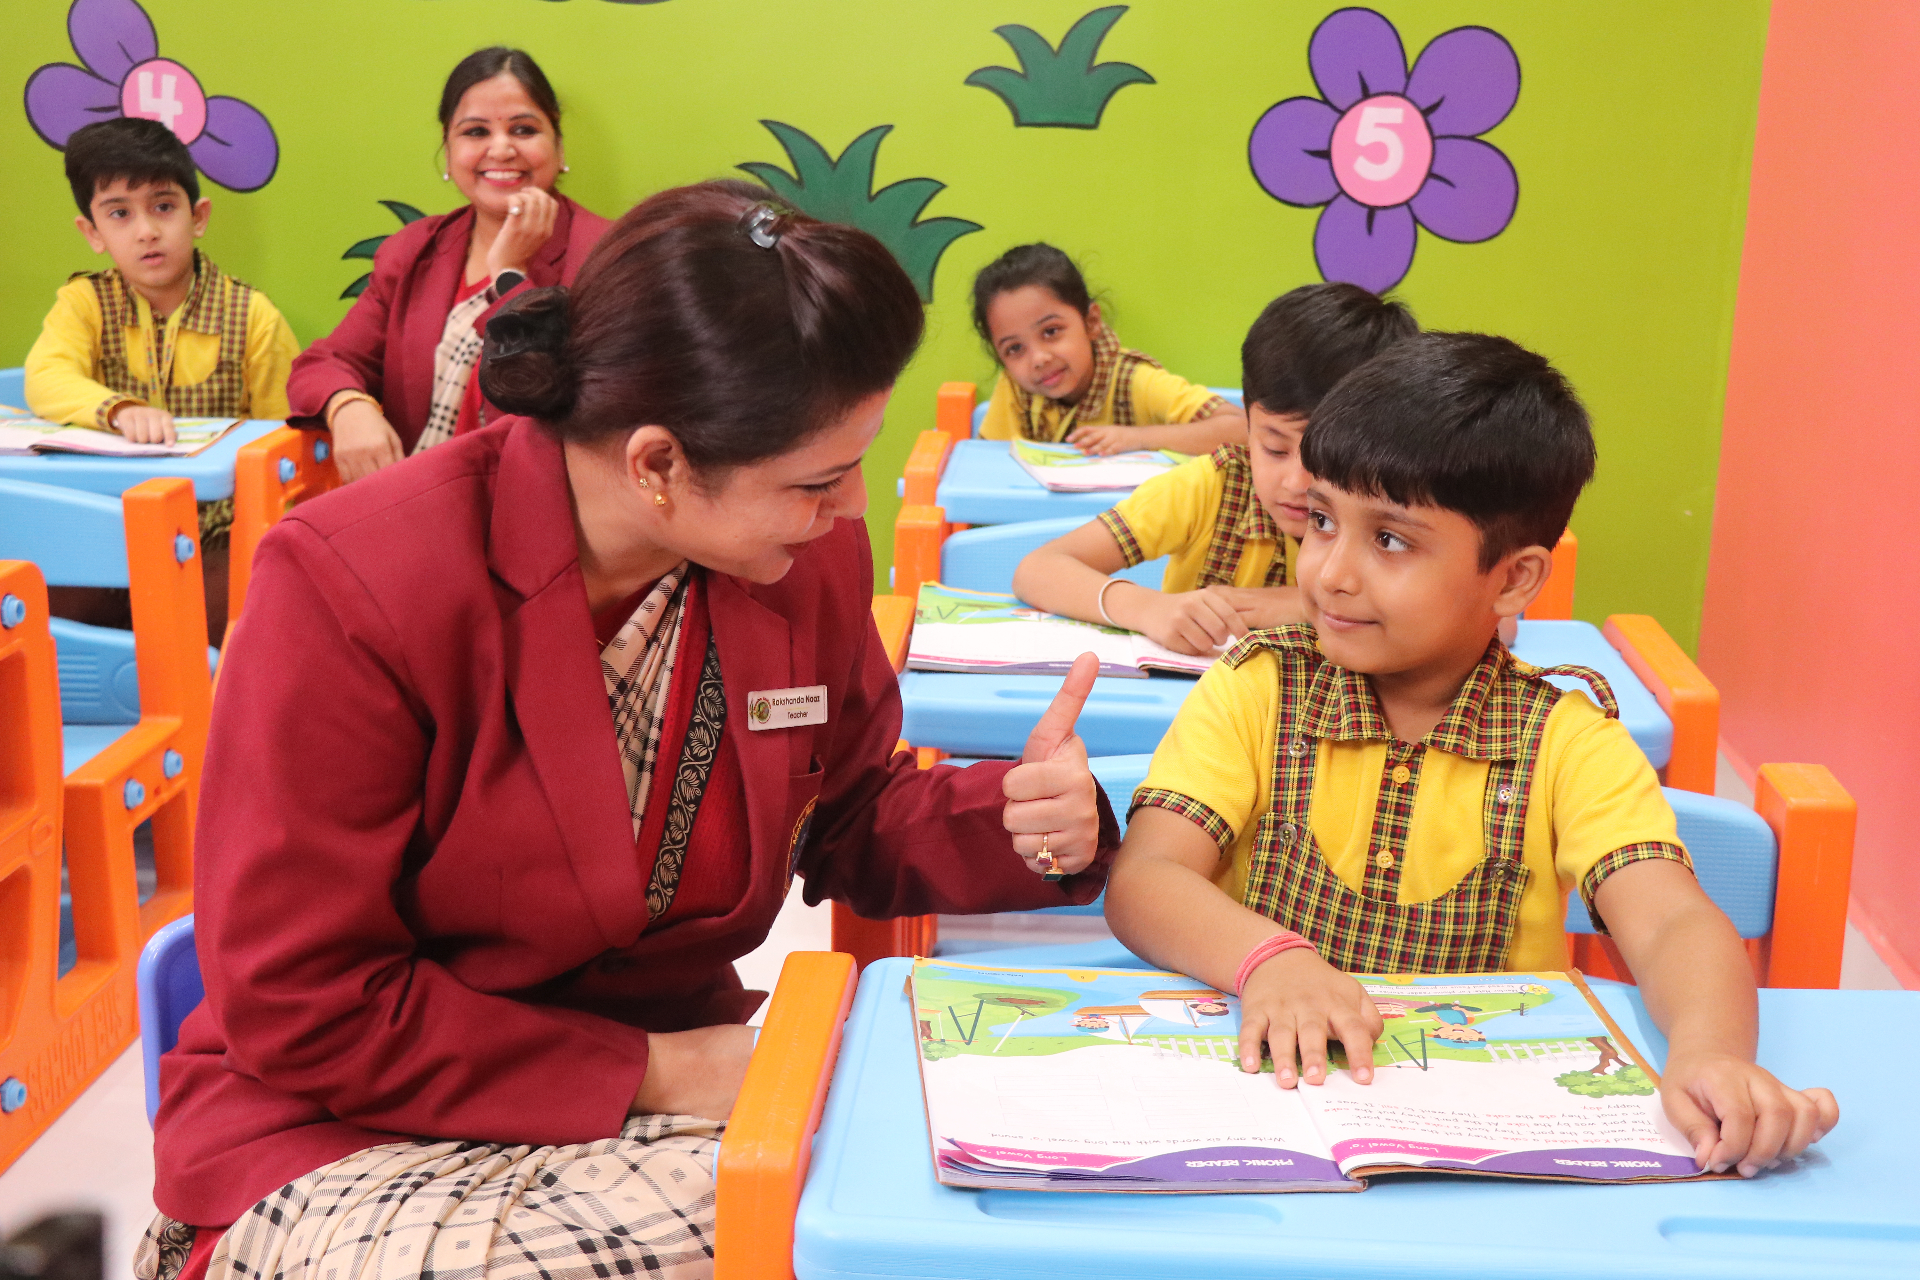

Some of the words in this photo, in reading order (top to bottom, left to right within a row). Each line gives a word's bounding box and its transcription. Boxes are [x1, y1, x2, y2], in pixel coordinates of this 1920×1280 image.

[138, 71, 183, 129] 4
[1353, 106, 1404, 181] 5
[787, 710, 808, 719] Teacher
[1407, 1143, 1439, 1154] Long
[996, 1150, 1033, 1159] Vowel
[1036, 1153, 1068, 1162] Long
[1184, 1159, 1240, 1168] READER
[1241, 1159, 1295, 1167] PHONIC
[1552, 1159, 1609, 1168] READER
[1609, 1160, 1663, 1168] PHONIC
